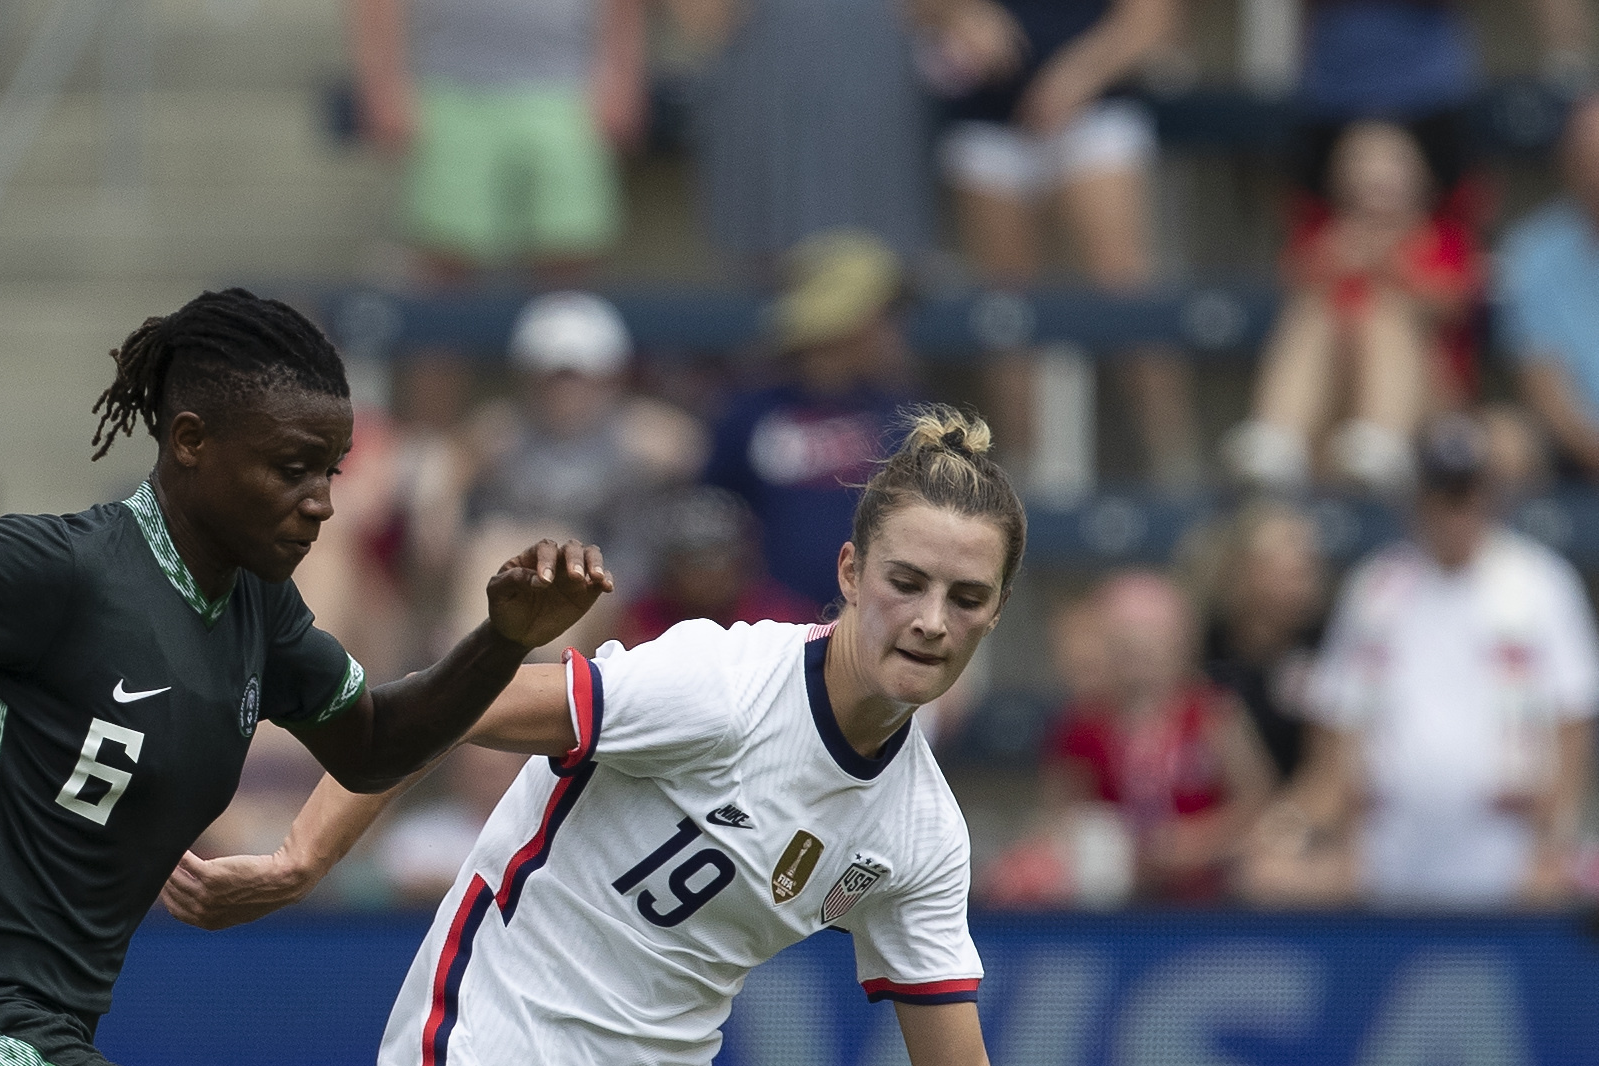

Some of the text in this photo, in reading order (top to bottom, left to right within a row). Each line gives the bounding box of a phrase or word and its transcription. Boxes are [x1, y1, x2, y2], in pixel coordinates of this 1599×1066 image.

[54, 717, 145, 826] 6
[717, 804, 750, 826] NIKE
[611, 815, 737, 928] 19
[845, 868, 873, 894] USA
